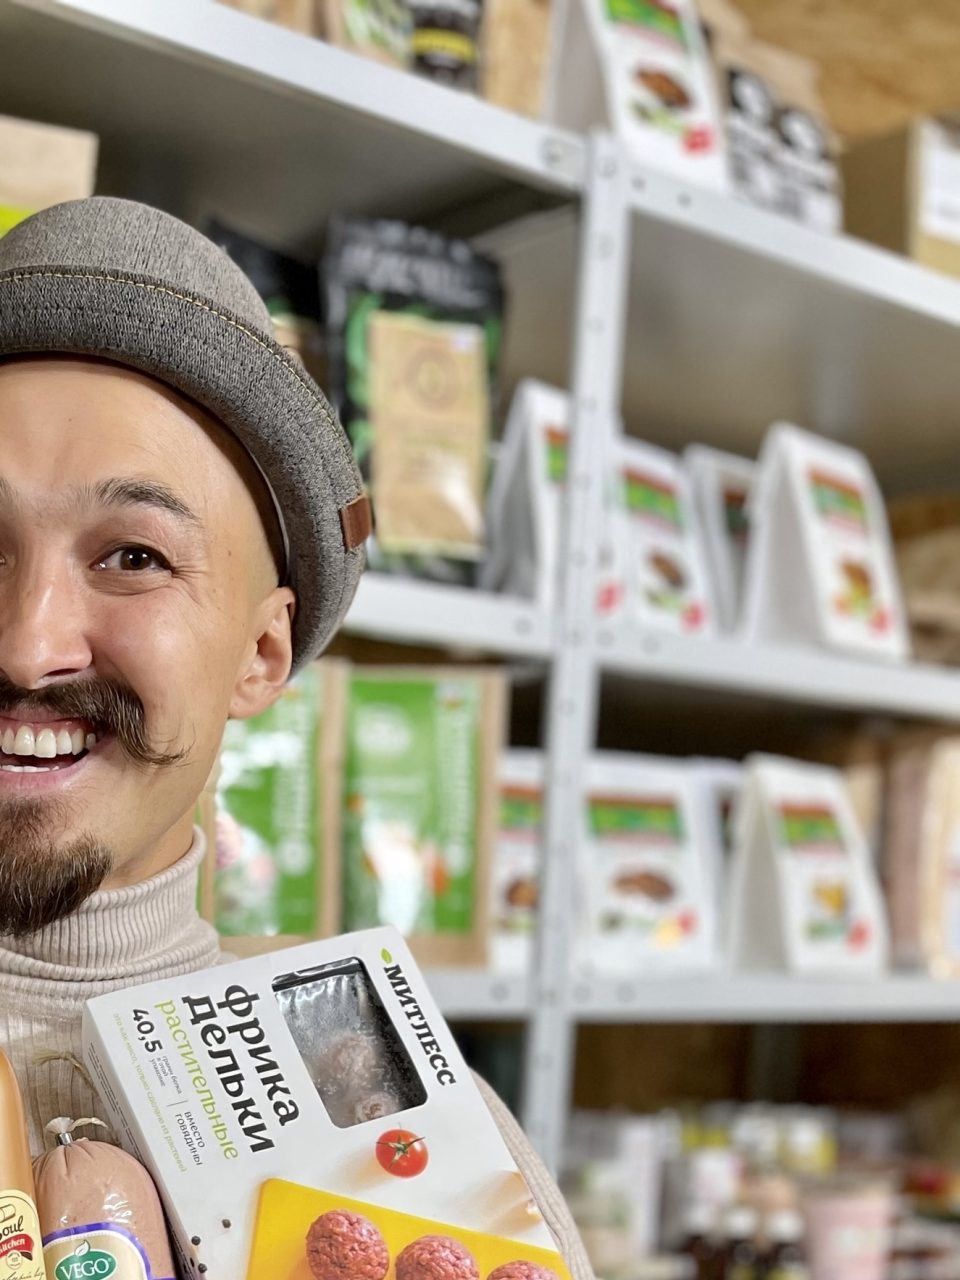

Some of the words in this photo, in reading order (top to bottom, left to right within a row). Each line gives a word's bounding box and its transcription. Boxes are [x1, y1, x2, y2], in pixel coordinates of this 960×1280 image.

[133, 1009, 163, 1052] 40,5
[217, 985, 300, 1126] фрика
[384, 964, 456, 1086] МИТЛЕСС
[155, 1000, 238, 1159] растительные
[181, 996, 276, 1153] дельки
[176, 1114, 203, 1165] говядины
[184, 1112, 205, 1147] вместо
[60, 1258, 110, 1280] VEGO
